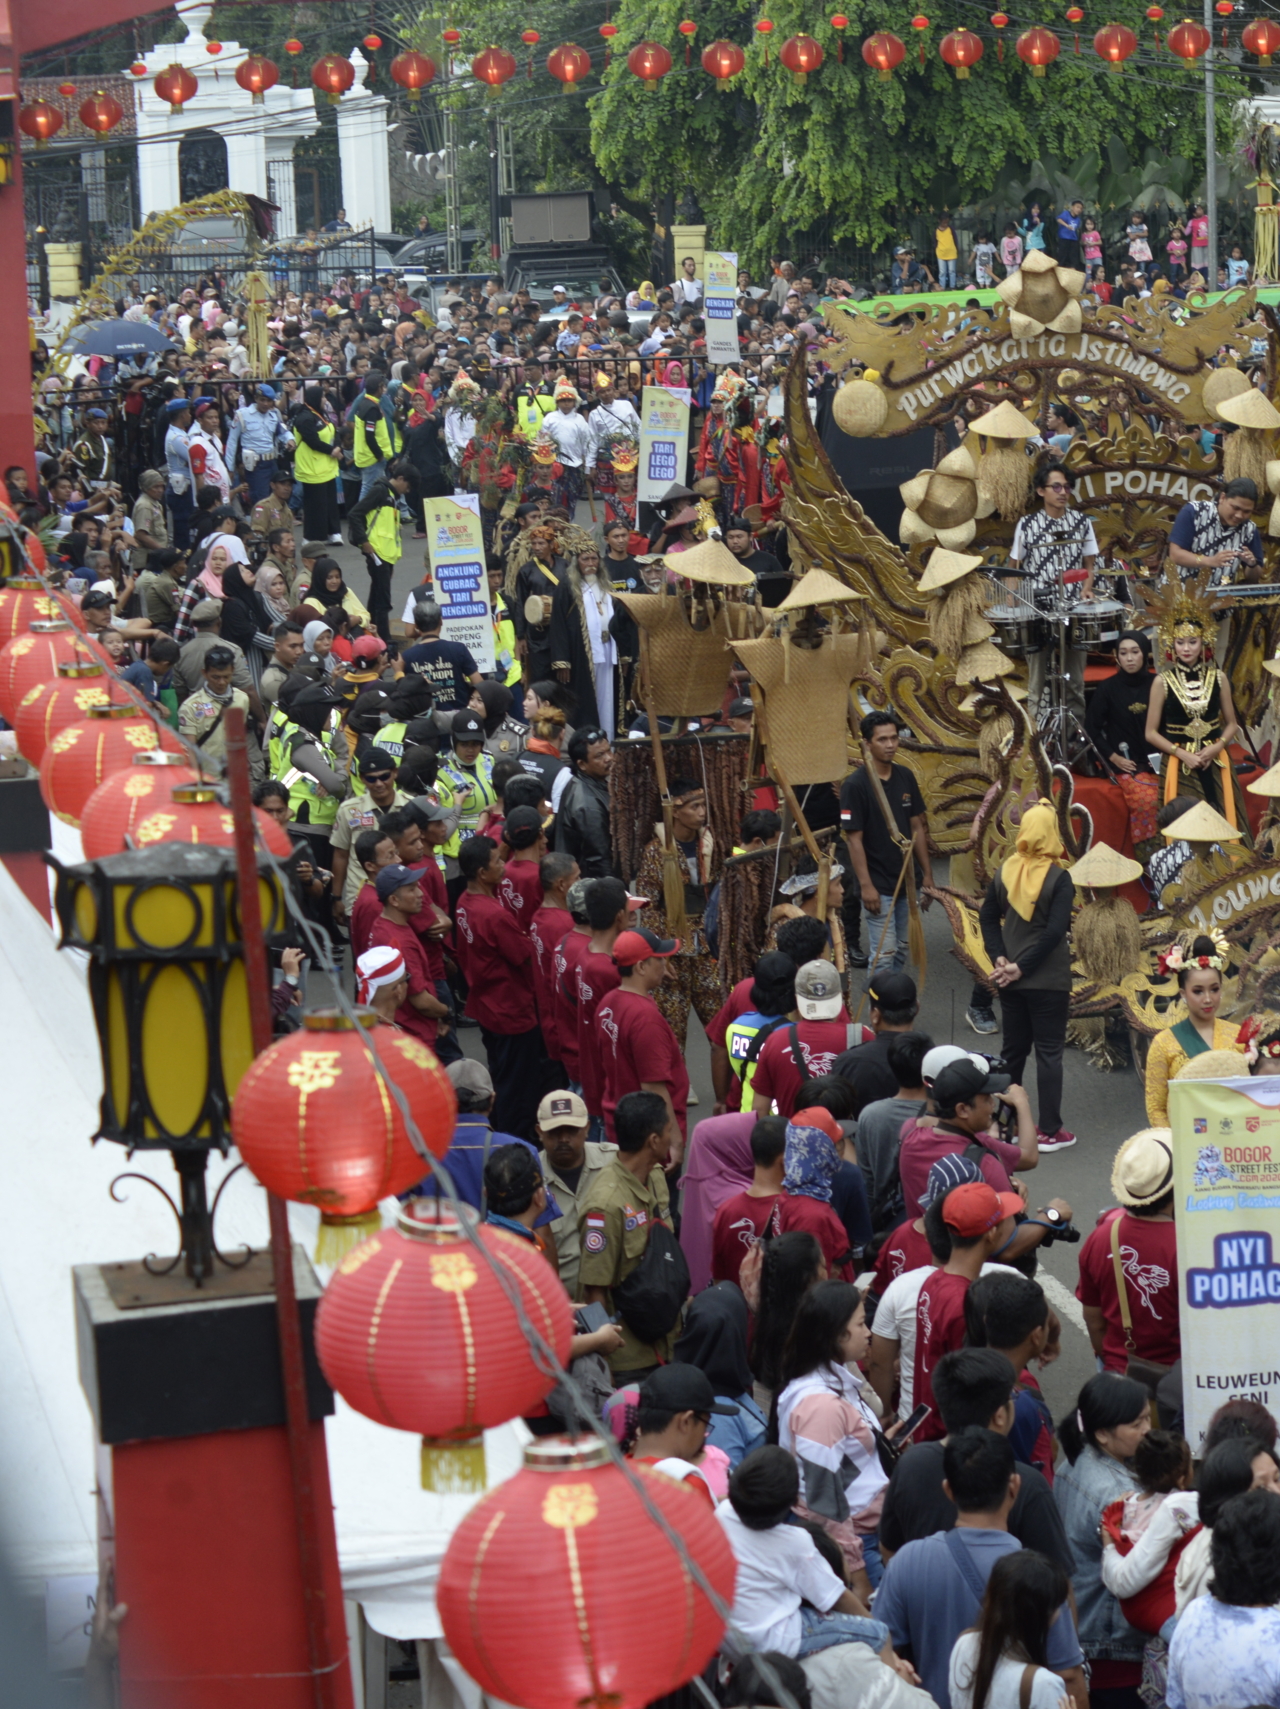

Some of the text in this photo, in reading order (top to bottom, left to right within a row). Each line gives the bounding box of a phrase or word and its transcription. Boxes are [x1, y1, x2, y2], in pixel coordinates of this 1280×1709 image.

[654, 443, 674, 454] TARI
[651, 455, 675, 466] LEGO
[650, 467, 675, 479] LEGO
[1071, 470, 1213, 503] YI POHAC
[448, 525, 468, 534] BOGOR
[438, 565, 480, 578] ANGKLUNG
[443, 578, 478, 590] GUBRAG,
[452, 592, 470, 603] TARI
[442, 604, 485, 617] RENGKONG
[446, 624, 484, 633] PADEPOKAN
[450, 633, 481, 642] TOPENG
[466, 641, 483, 650] RAK
[433, 669, 454, 680] KOPI
[1224, 1146, 1272, 1163] BOGOR
[1230, 1164, 1260, 1174] STREET
[1186, 1194, 1235, 1212] Looking
[1221, 1237, 1265, 1268] NYI
